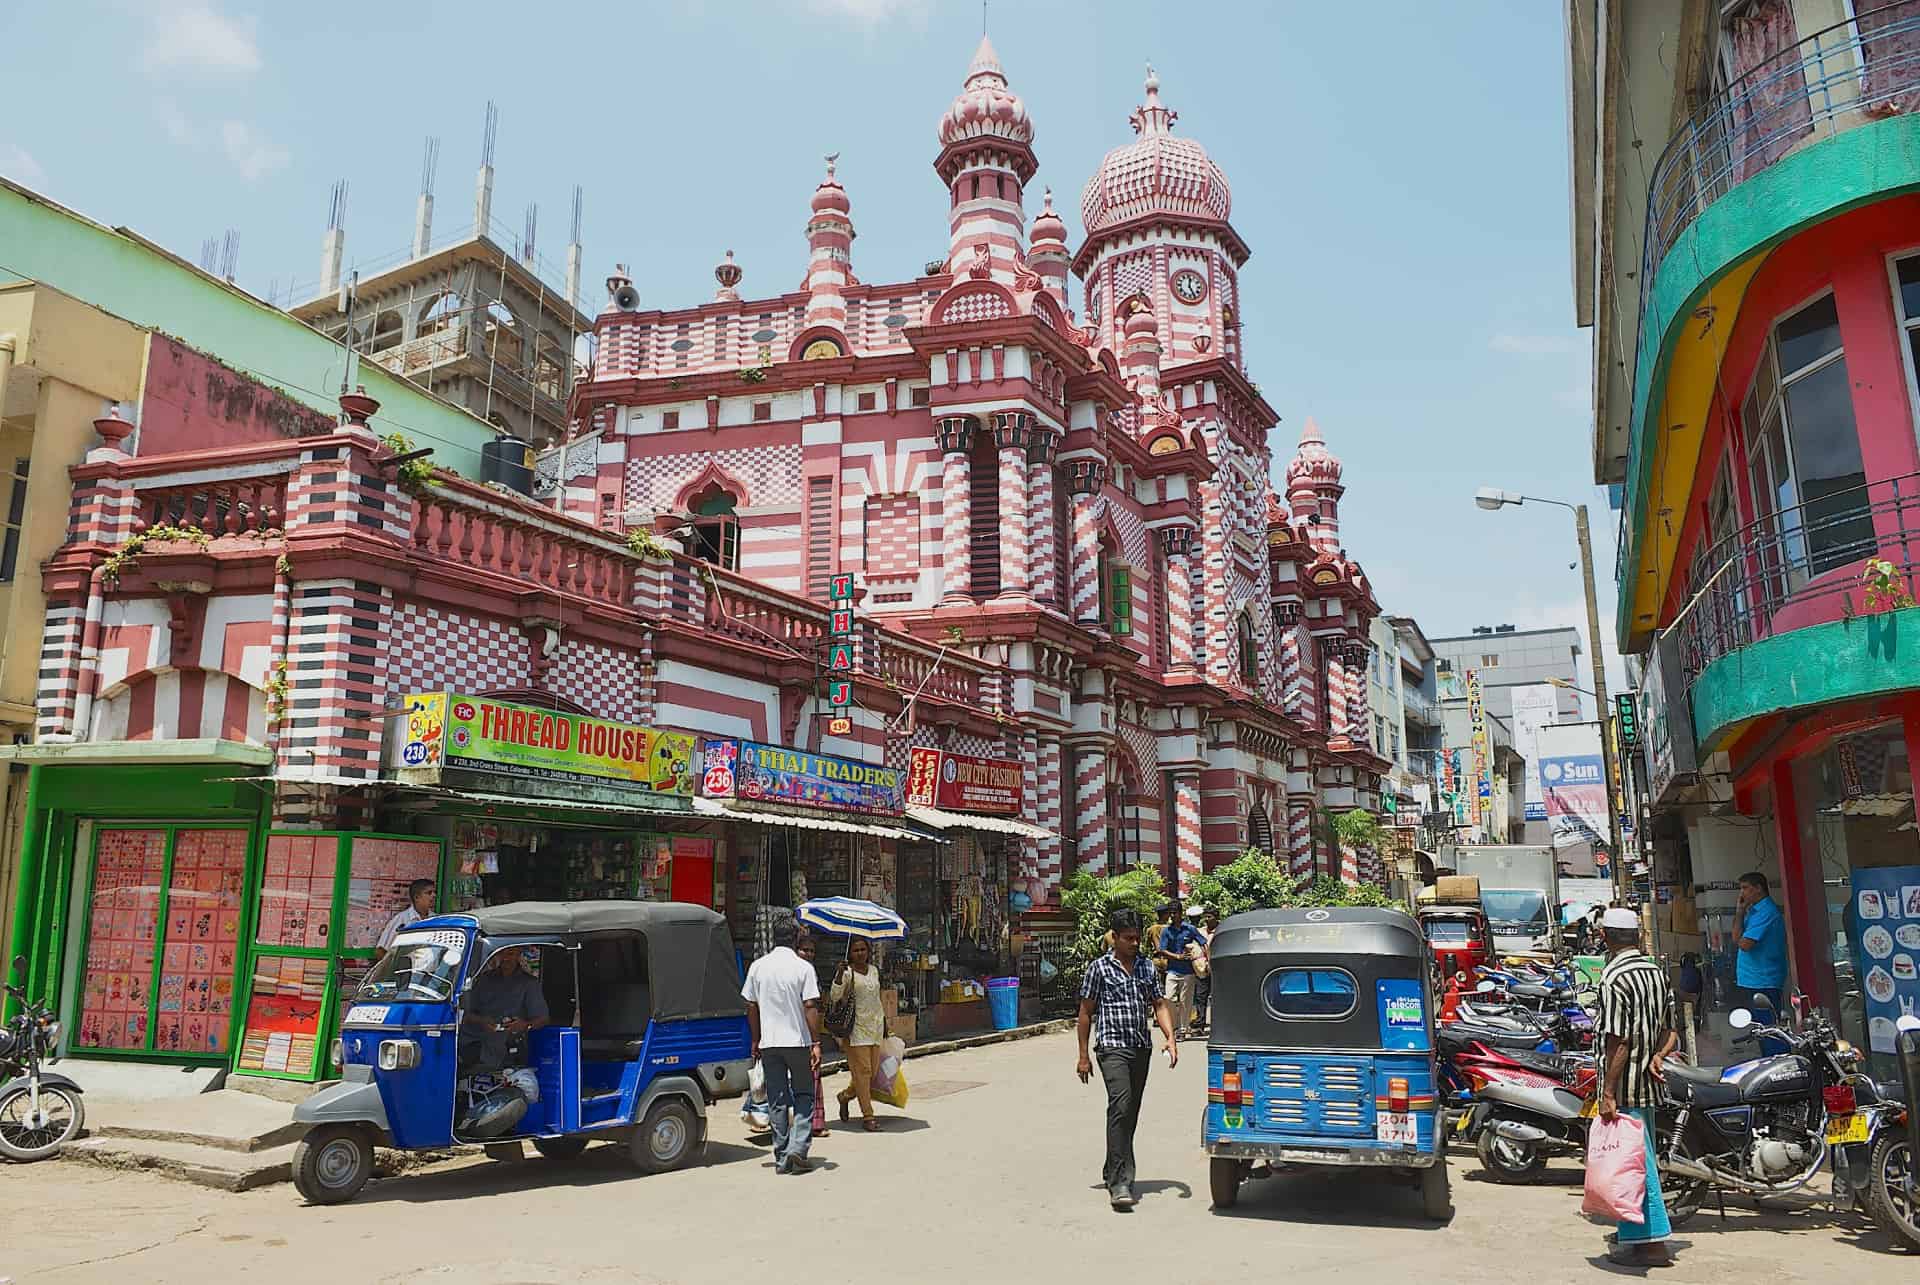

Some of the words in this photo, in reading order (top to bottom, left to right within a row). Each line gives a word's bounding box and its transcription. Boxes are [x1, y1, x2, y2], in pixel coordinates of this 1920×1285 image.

[833, 576, 849, 705] THAJ
[480, 704, 570, 751] THREAD
[578, 721, 647, 763] HOUSE
[406, 745, 425, 760] 238
[758, 748, 808, 774] THAJ
[815, 759, 897, 788] TRADERS
[973, 764, 989, 785] CITY
[990, 767, 1021, 788] FASHION
[1563, 761, 1599, 778] Sun
[707, 771, 730, 788] 236
[1490, 927, 1518, 935] ISUZU
[1385, 998, 1421, 1009] Telecom
[1380, 1114, 1414, 1125] 204-
